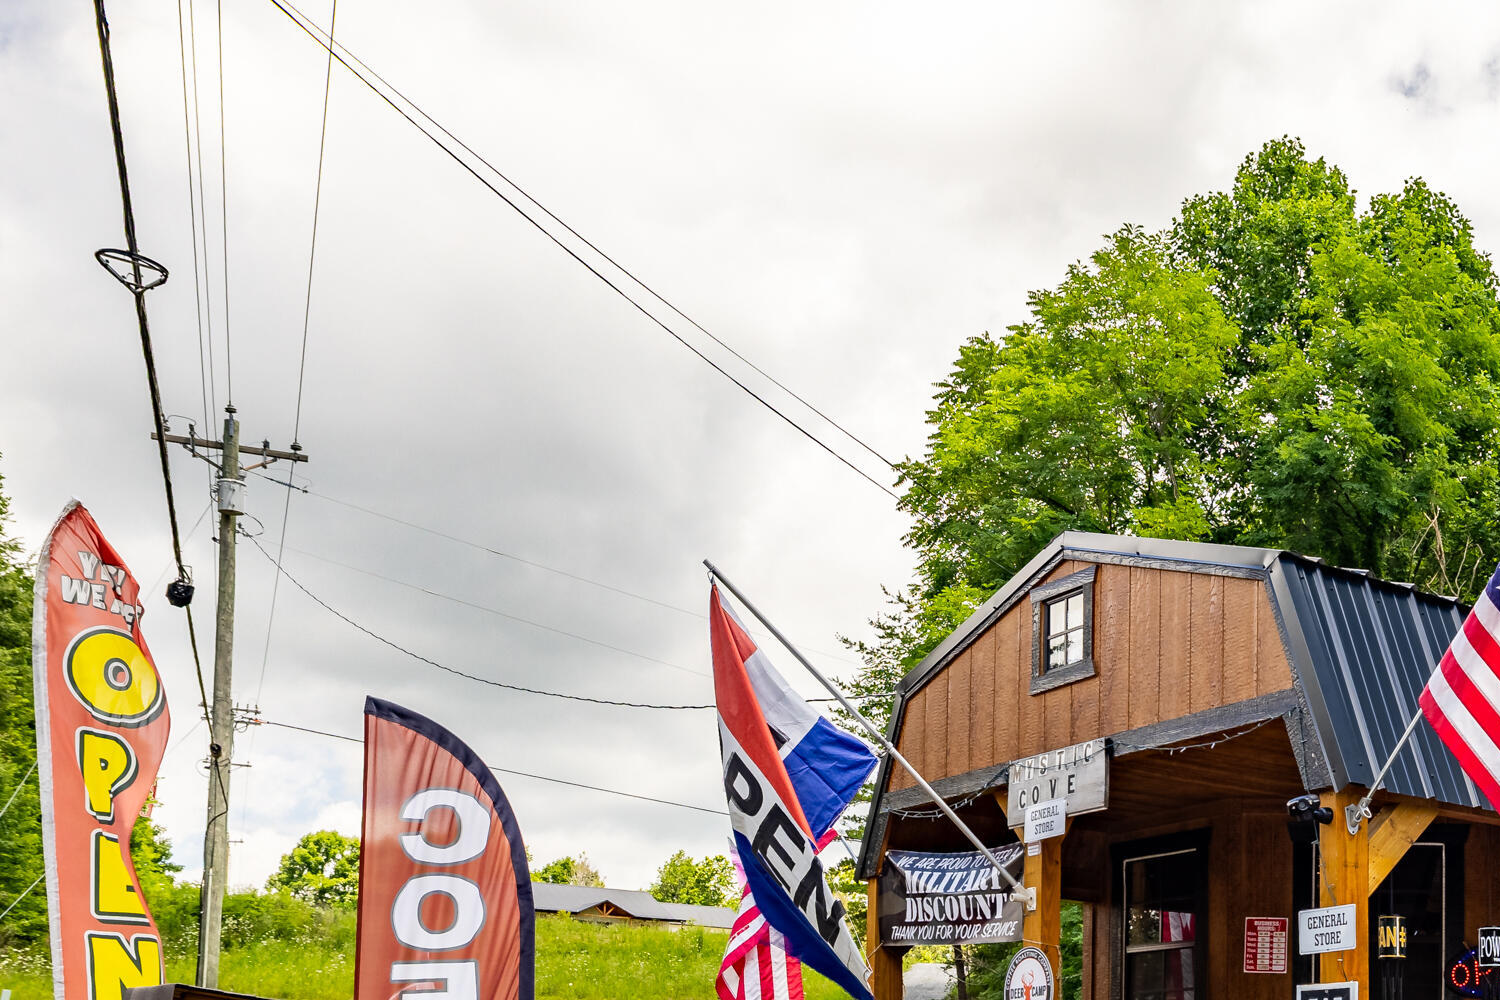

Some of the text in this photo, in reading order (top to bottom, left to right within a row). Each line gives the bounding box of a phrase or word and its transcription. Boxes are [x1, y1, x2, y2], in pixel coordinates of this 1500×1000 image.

[61, 574, 107, 611] WE
[1013, 743, 1092, 783] MYSTIC
[1019, 774, 1076, 809] COVE
[1031, 805, 1060, 821] GENERAL
[1034, 821, 1055, 836] STORE
[717, 737, 847, 947] PEN
[897, 855, 915, 867] WE
[915, 857, 937, 869] ARE
[938, 856, 972, 869] PROUD
[970, 855, 985, 868] TO
[904, 866, 1002, 895] MILITARY
[904, 893, 1008, 923] DISCOUNT
[891, 921, 1018, 940] THANK YOU FOR YOUR SERVICE
[1307, 912, 1348, 930] GENERAL
[1314, 931, 1342, 947] STORE
[1010, 985, 1046, 999] DEER CAMP
